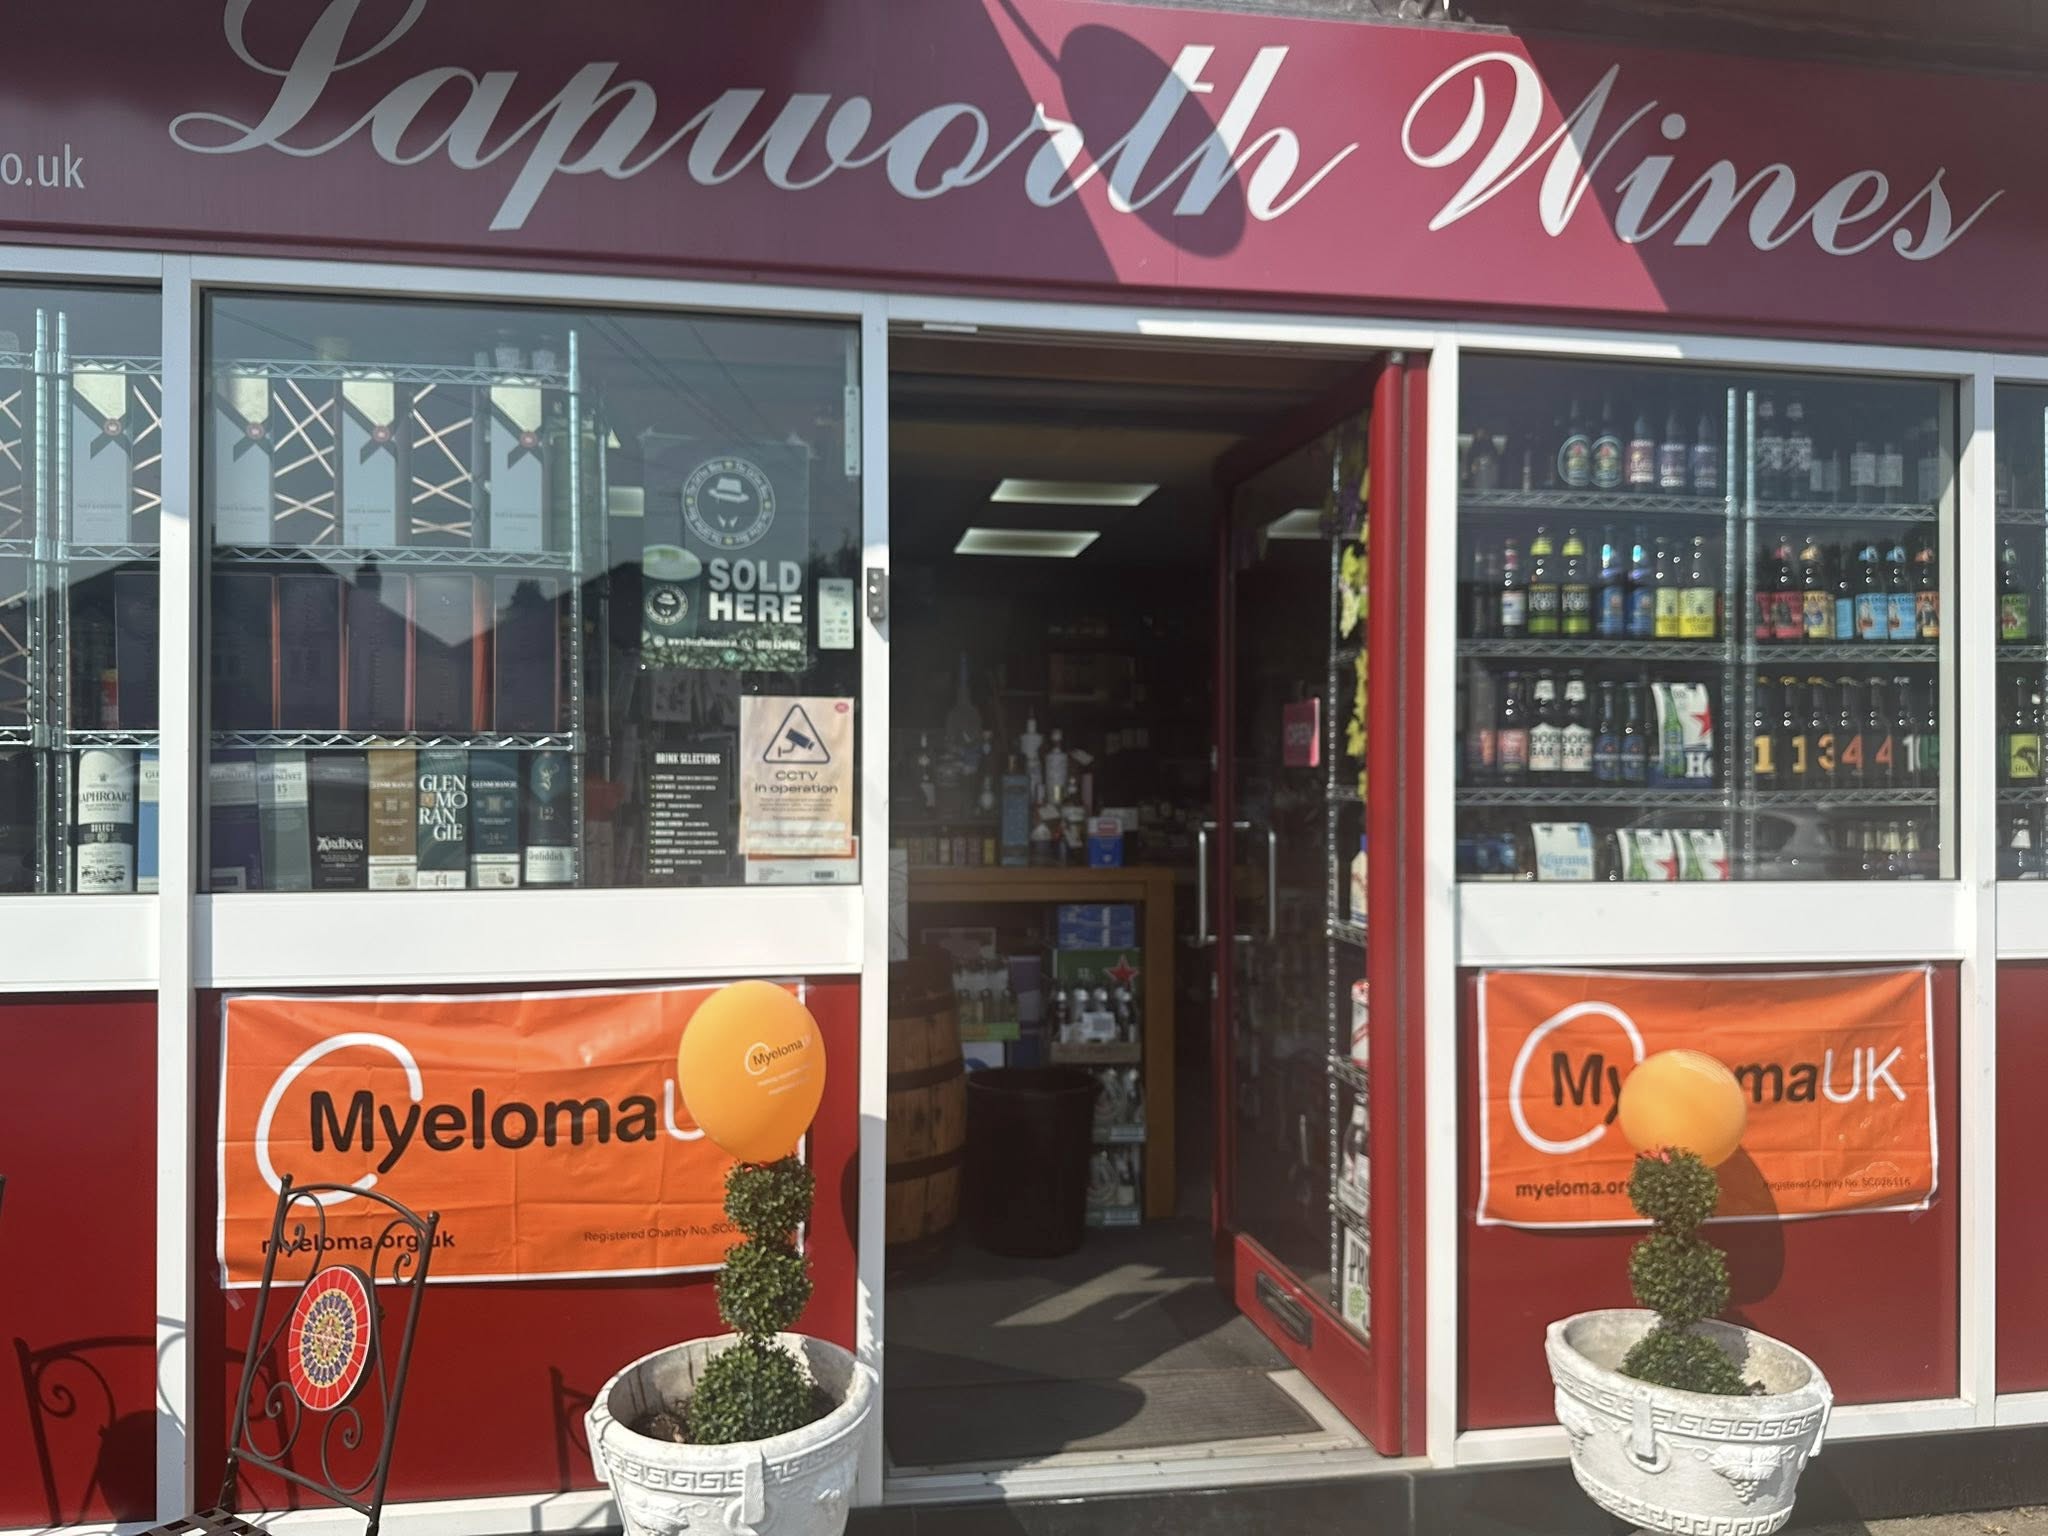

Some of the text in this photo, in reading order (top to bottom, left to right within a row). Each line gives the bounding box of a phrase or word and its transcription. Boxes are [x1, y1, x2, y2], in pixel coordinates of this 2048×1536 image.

[169, 0, 2005, 261] Lapworth Wines
[708, 557, 802, 593] SOLD
[708, 592, 803, 623] HERE
[655, 752, 721, 765] DRINK SELECTIONS
[1754, 735, 1775, 773] 1
[1841, 735, 1863, 772] 4
[1875, 735, 1894, 772] 4
[420, 774, 467, 792] GLEN
[775, 769, 819, 781] CCTV
[79, 790, 131, 803] APHROAIG
[754, 783, 839, 794] in operation
[436, 791, 469, 809] MO
[419, 808, 456, 825] RAN
[433, 823, 463, 841] GIE
[1812, 1177, 1843, 1190] Charity
[584, 1229, 645, 1243] Registered
[648, 1226, 688, 1240] Charity
[261, 1230, 456, 1258] myelomaorguk
